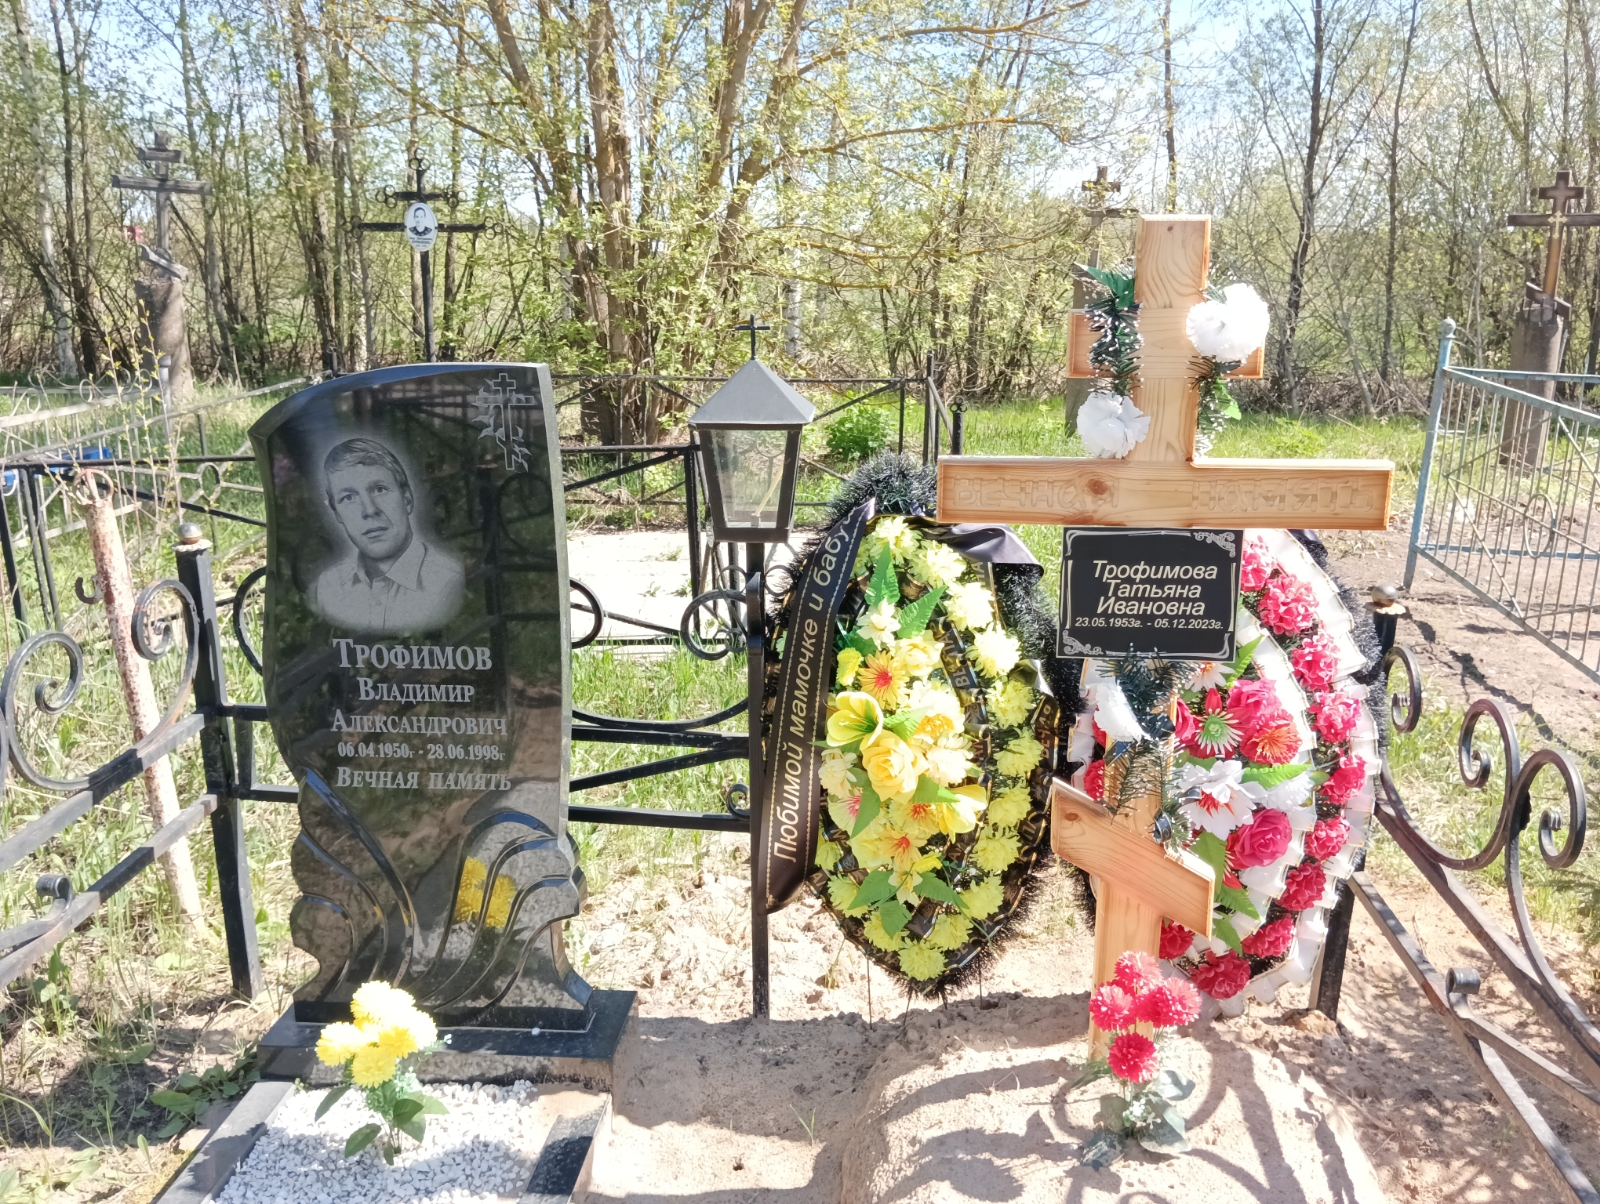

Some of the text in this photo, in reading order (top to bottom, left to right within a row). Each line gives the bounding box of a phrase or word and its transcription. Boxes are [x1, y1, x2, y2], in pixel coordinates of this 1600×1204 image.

[1093, 560, 1218, 583] Трофимова
[1106, 579, 1202, 598] Татьяна
[1096, 596, 1206, 616] Ивановна
[1075, 617, 1143, 628] 23.05.1953г.
[1154, 618, 1224, 630] 05.12.2023г.
[333, 638, 493, 671] ТРОФИМОВ
[773, 742, 803, 863] Любимой
[790, 618, 818, 739] мамочке
[808, 593, 824, 612] и
